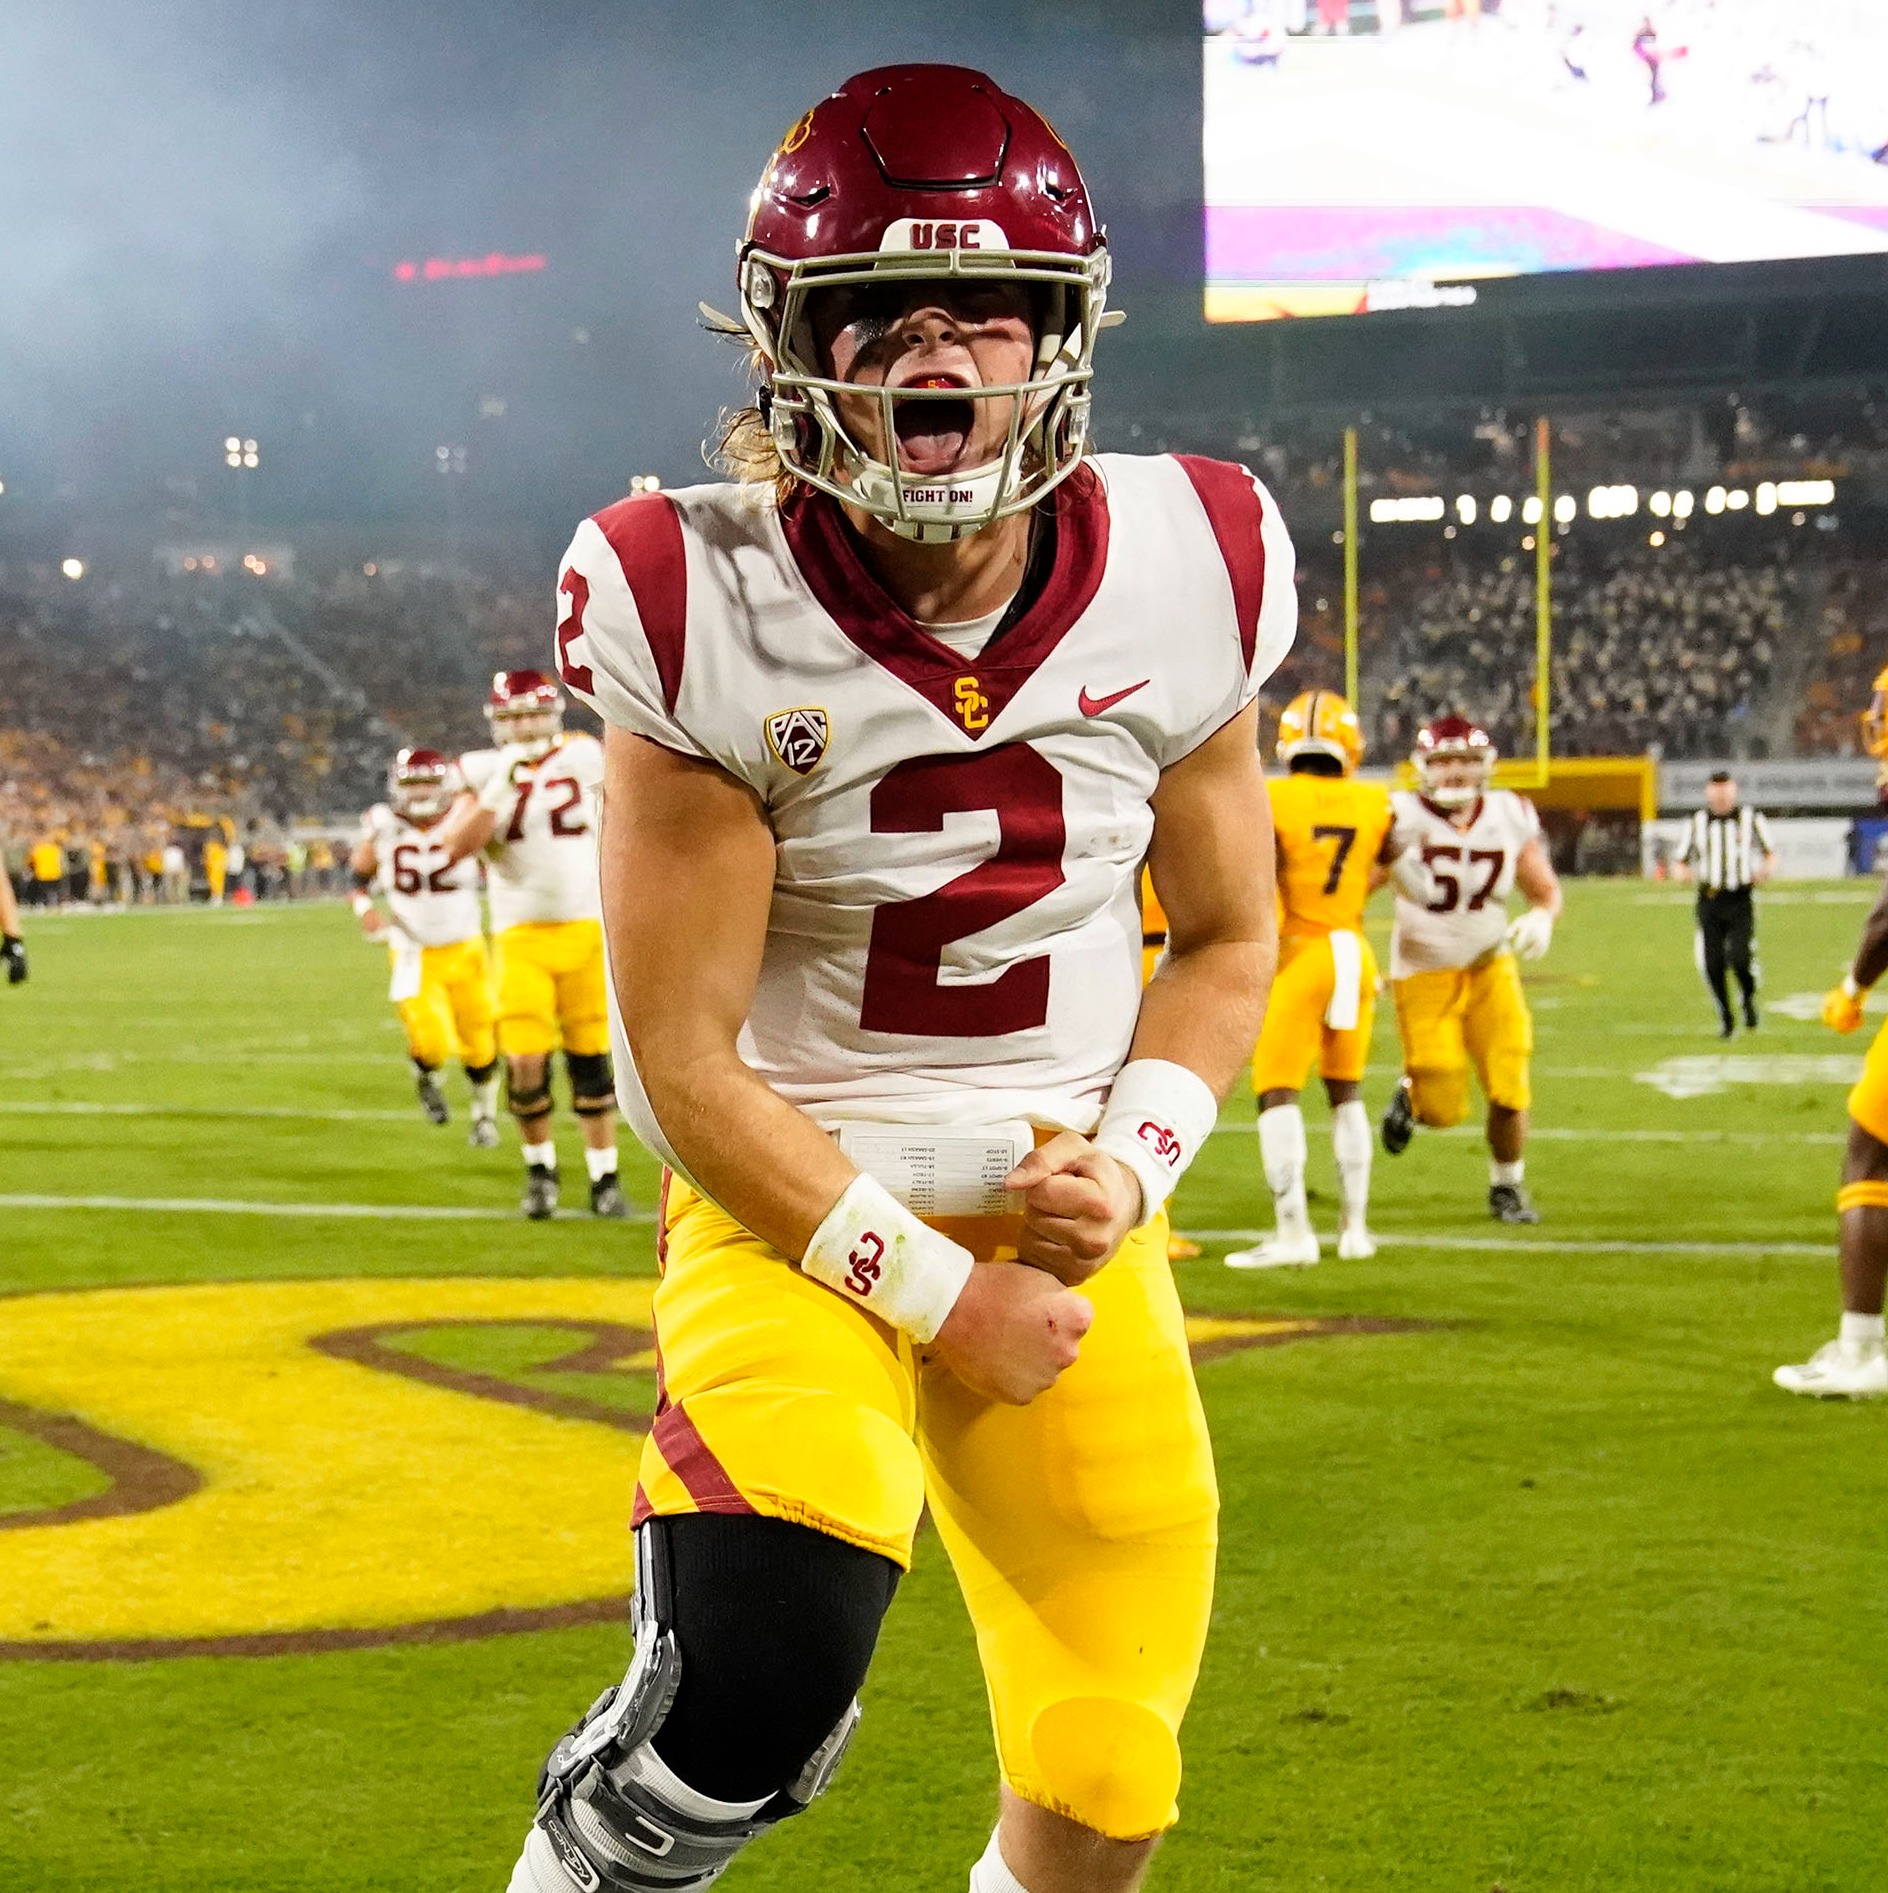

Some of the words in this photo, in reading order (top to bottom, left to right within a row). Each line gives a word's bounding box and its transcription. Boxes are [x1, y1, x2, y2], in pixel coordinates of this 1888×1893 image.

[911, 223, 980, 250] USC
[902, 490, 945, 502] FIGHT
[949, 490, 973, 502] ON!
[558, 565, 595, 696] 2
[954, 676, 989, 730] SC
[770, 710, 827, 756] PAC
[787, 738, 818, 766] 12
[506, 777, 587, 841] 72
[394, 844, 461, 897] 62
[1312, 826, 1356, 894] 7
[1422, 846, 1504, 912] 57
[859, 742, 1066, 1037] 2
[548, 1819, 589, 1879] DONJOY
